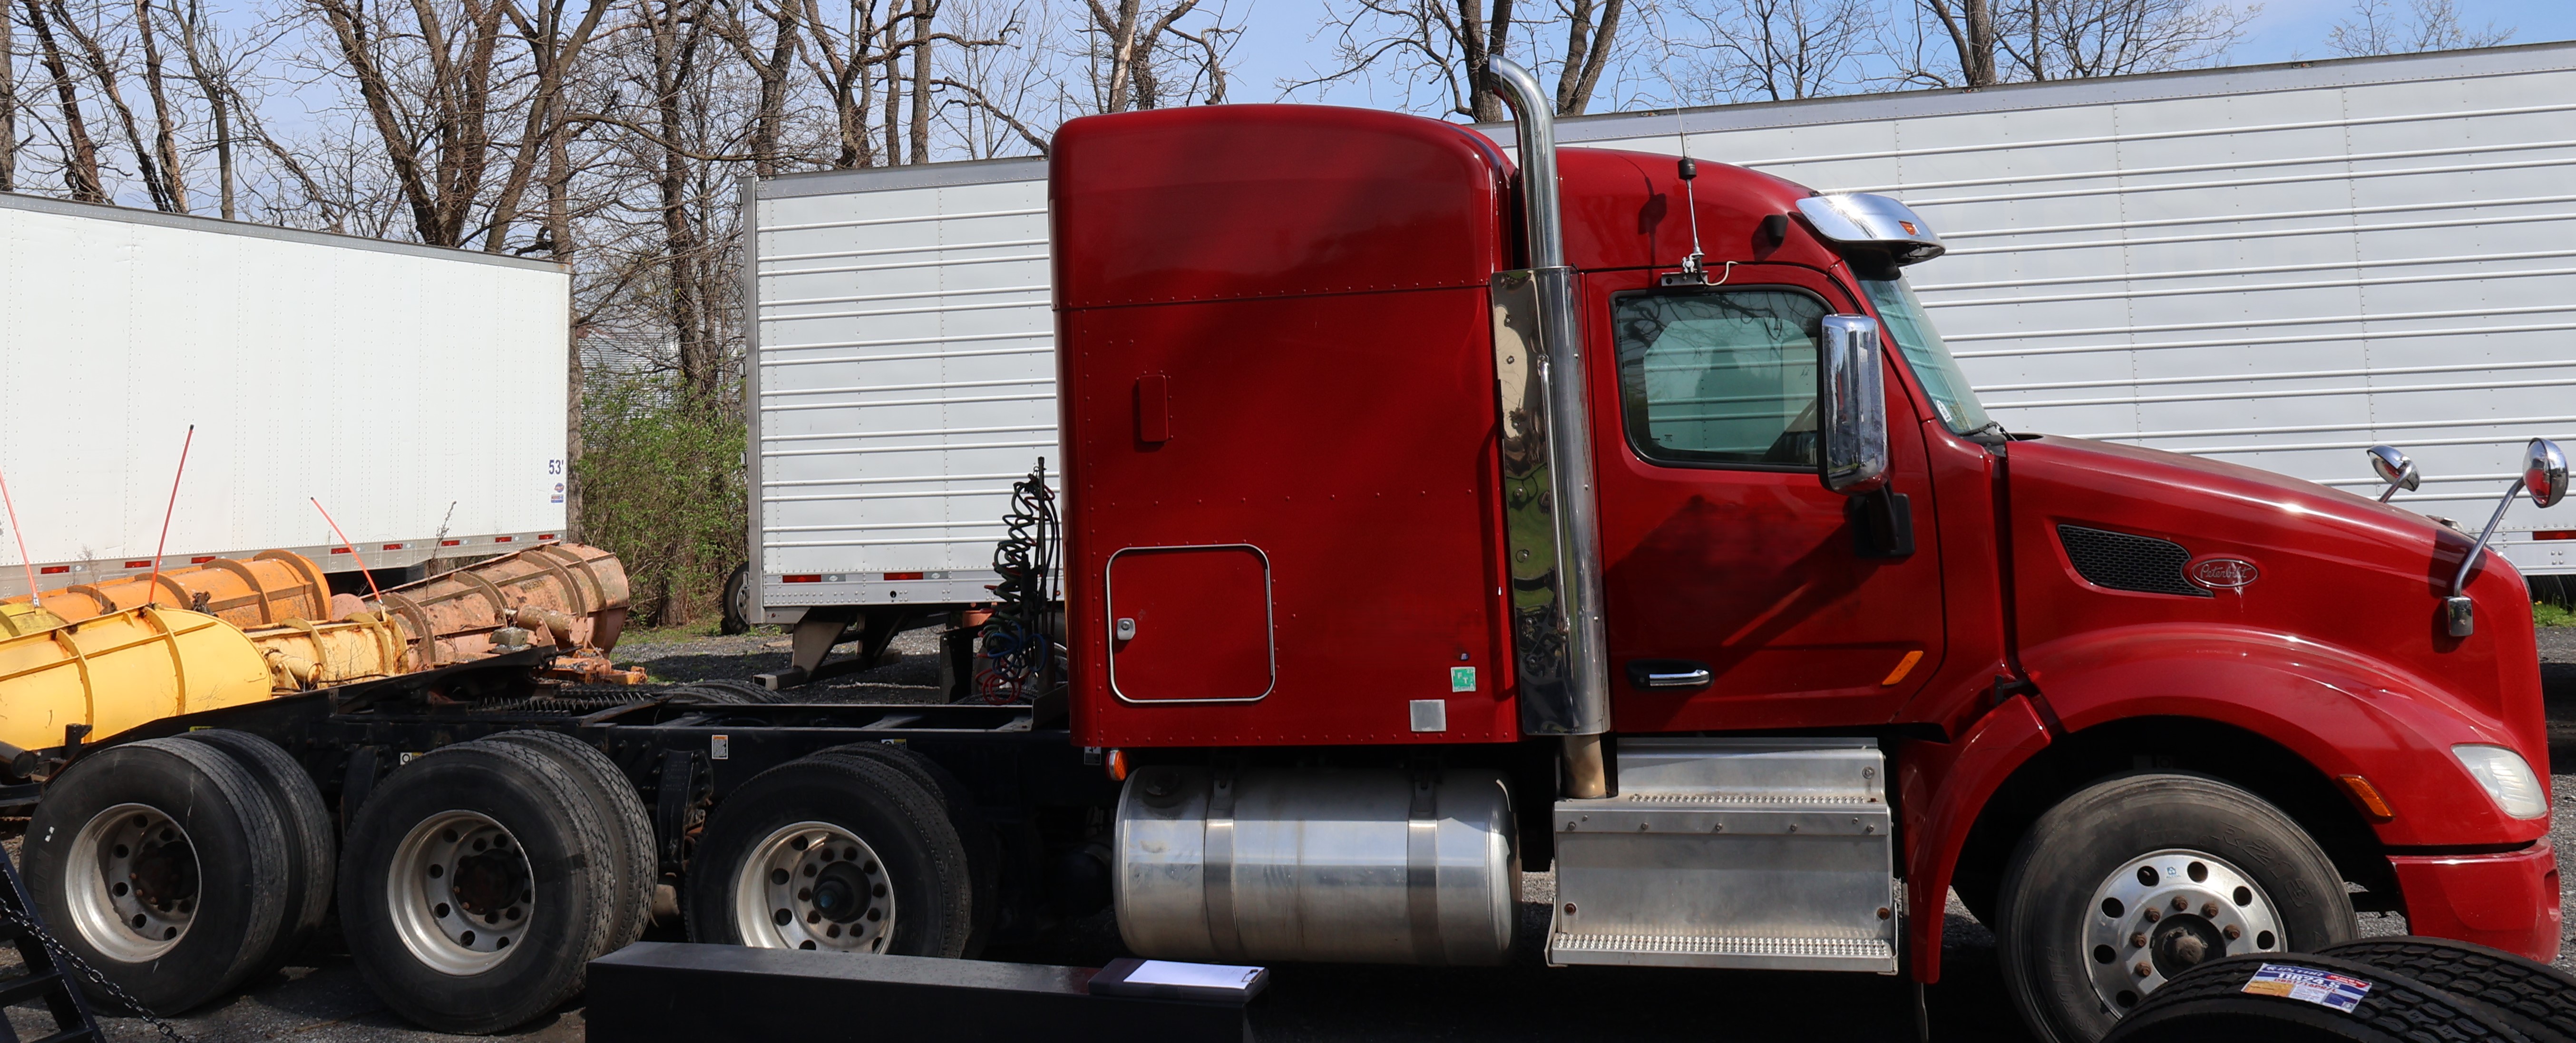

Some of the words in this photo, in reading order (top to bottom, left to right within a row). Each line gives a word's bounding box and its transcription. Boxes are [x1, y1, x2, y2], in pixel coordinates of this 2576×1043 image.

[549, 459, 564, 474] 53'
[2200, 564, 2252, 579] Peterbilt
[2278, 973, 2341, 988] 11R24.5
